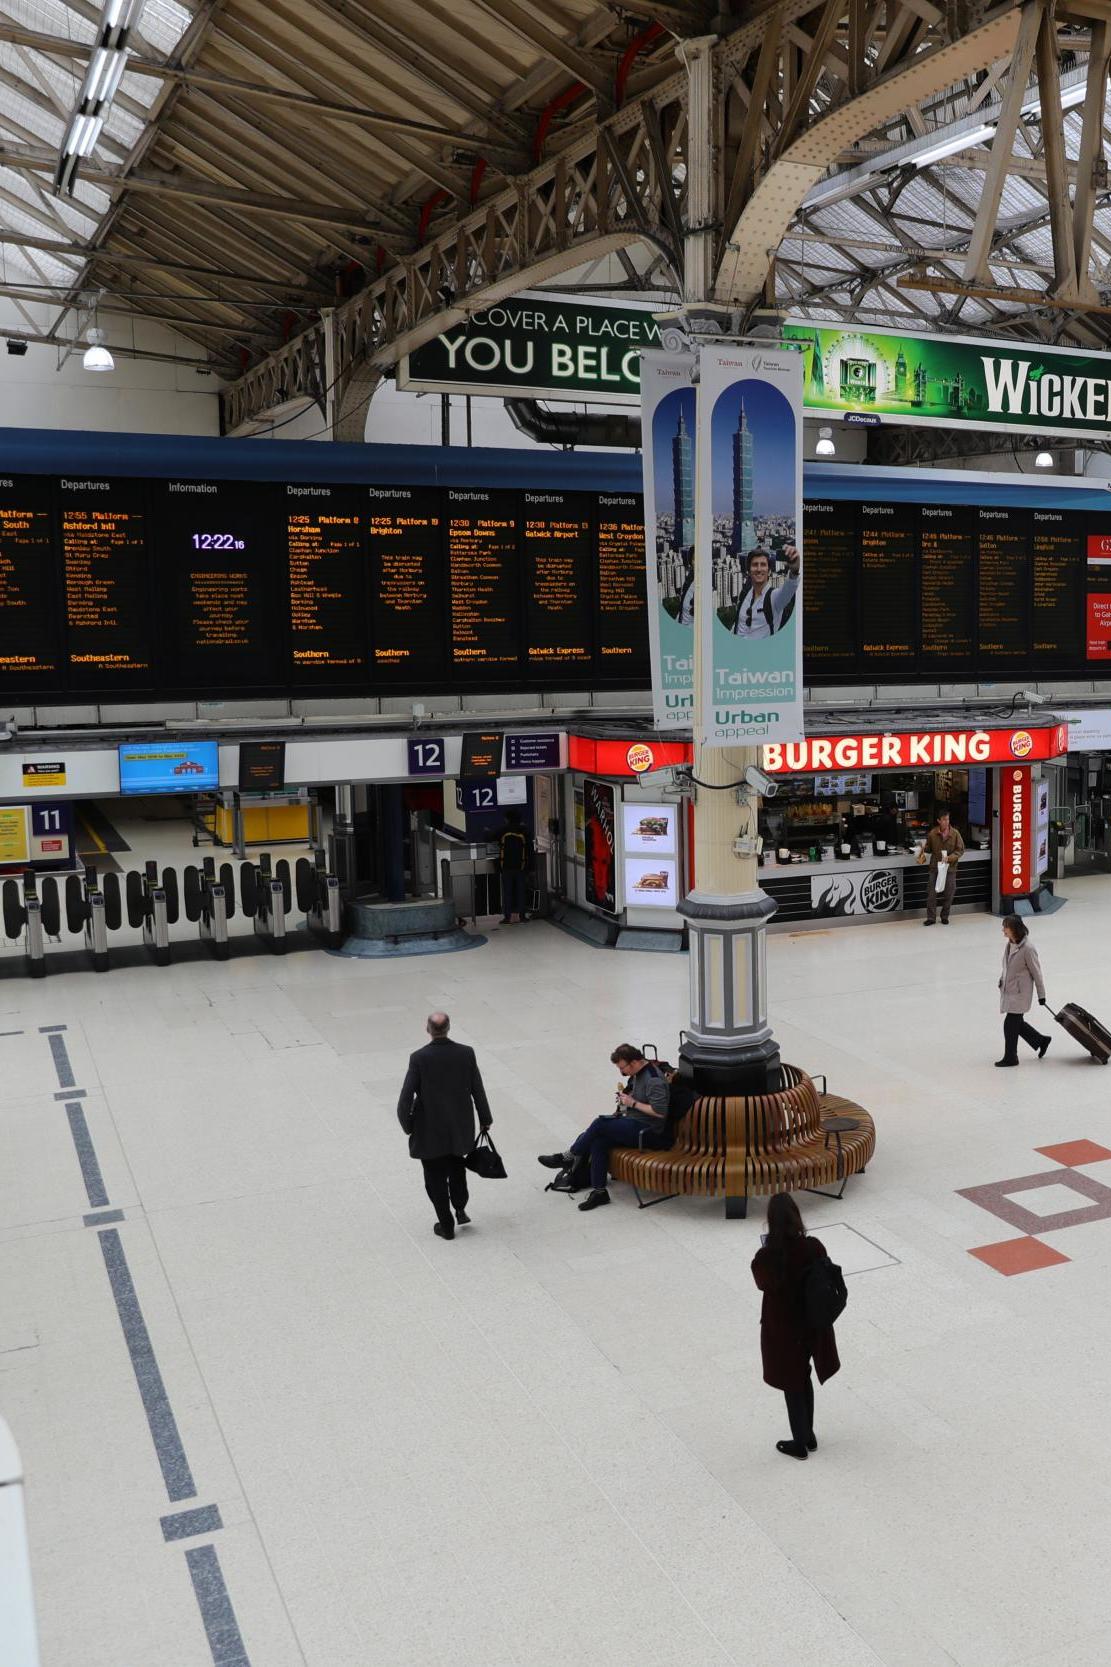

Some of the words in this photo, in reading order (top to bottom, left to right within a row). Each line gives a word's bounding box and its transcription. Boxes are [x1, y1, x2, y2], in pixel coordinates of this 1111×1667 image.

[461, 307, 547, 332] COVER
[553, 315, 569, 333] A
[577, 317, 641, 340] PLACE
[439, 334, 533, 374] YOU
[717, 359, 743, 368] Taiwan
[61, 480, 110, 491] Departures
[169, 483, 217, 494] Information
[287, 486, 331, 497] Departures
[369, 488, 411, 499] Departures
[449, 491, 489, 501] Departures
[525, 494, 563, 503] Departures
[599, 496, 636, 505] Departures
[0, 510, 33, 519] latform
[64, 511, 87, 519] 12:55
[862, 506, 894, 515] Departures
[922, 508, 952, 517] Departures
[979, 511, 1008, 519] Departures
[371, 517, 392, 525] 12:25
[1034, 512, 1062, 521] Departures
[4, 521, 30, 529] South
[450, 519, 469, 527] 12:30
[477, 520, 507, 528] Platform
[370, 527, 402, 535] Brighton
[193, 533, 234, 550] 12:22
[235, 540, 245, 550] 16
[1093, 602, 1108, 610] Direct
[293, 650, 328, 658] Southern
[375, 649, 409, 657] Southern
[557, 647, 584, 655] Express
[71, 654, 129, 662] Southeastern
[663, 655, 693, 671] Tai
[715, 668, 794, 685] Taiwan
[716, 688, 794, 701] Impression
[715, 710, 779, 725] Urban
[715, 725, 768, 739] appeal
[1014, 740, 1031, 752] KING
[413, 743, 441, 766] 12
[627, 749, 650, 760] BURGER
[763, 735, 901, 771] BURGER
[909, 733, 991, 764] KING
[628, 754, 651, 766] KING
[472, 787, 494, 807] 12
[1012, 784, 1022, 839] BURGER
[39, 810, 60, 830] 11
[1012, 841, 1022, 876] KING
[864, 875, 897, 897] BURGER
[866, 884, 899, 907] KING
